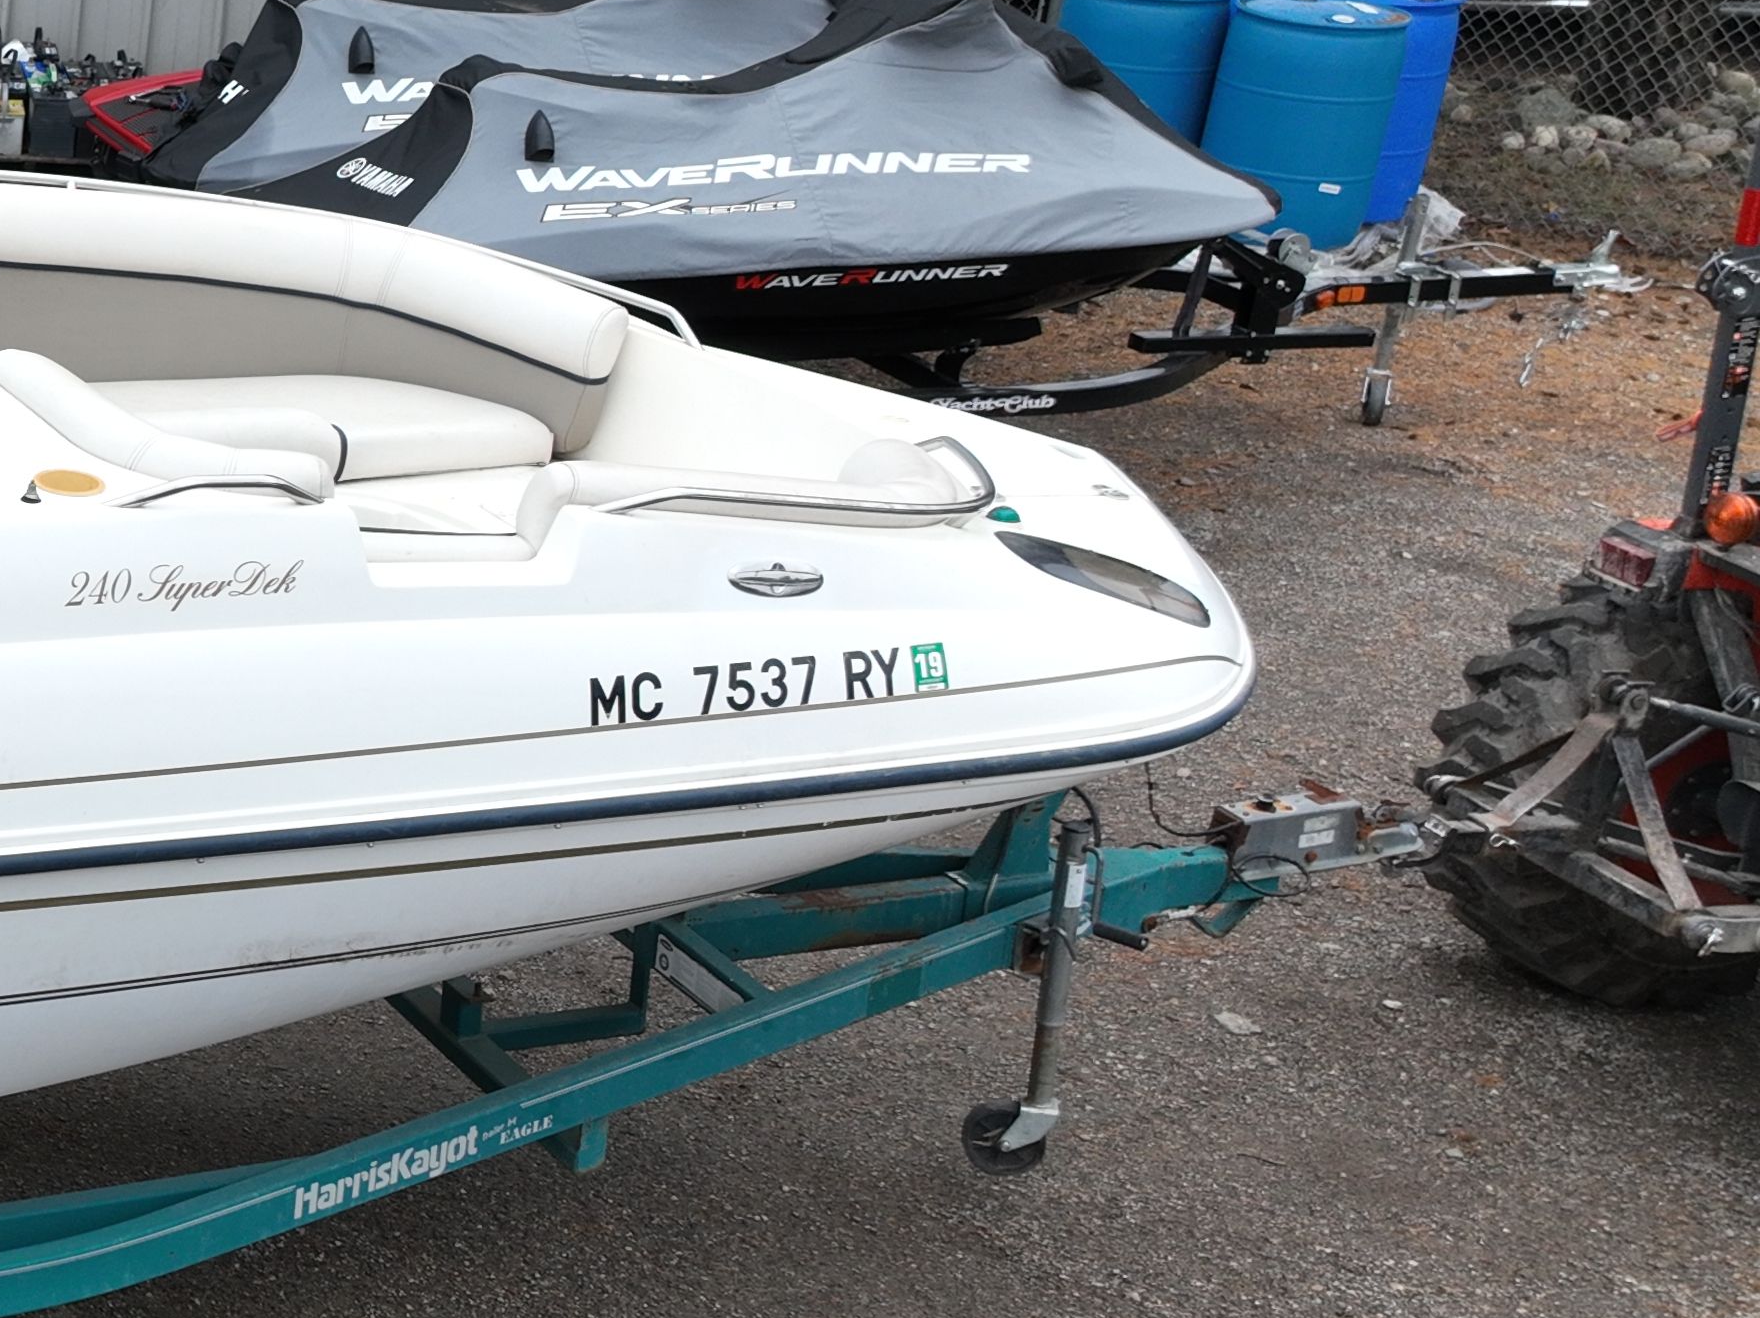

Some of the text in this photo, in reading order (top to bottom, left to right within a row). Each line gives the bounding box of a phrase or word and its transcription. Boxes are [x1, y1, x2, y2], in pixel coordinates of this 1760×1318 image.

[350, 163, 415, 198] YAMAHA
[539, 197, 798, 224] EX SERIES
[1003, 394, 1057, 414] Club
[64, 559, 304, 612] 240 SuperDek
[914, 651, 945, 679] 19
[589, 646, 900, 727] MC 7537 RY
[499, 1114, 555, 1146] EAGLE
[293, 1124, 479, 1220] HarrisKayot
